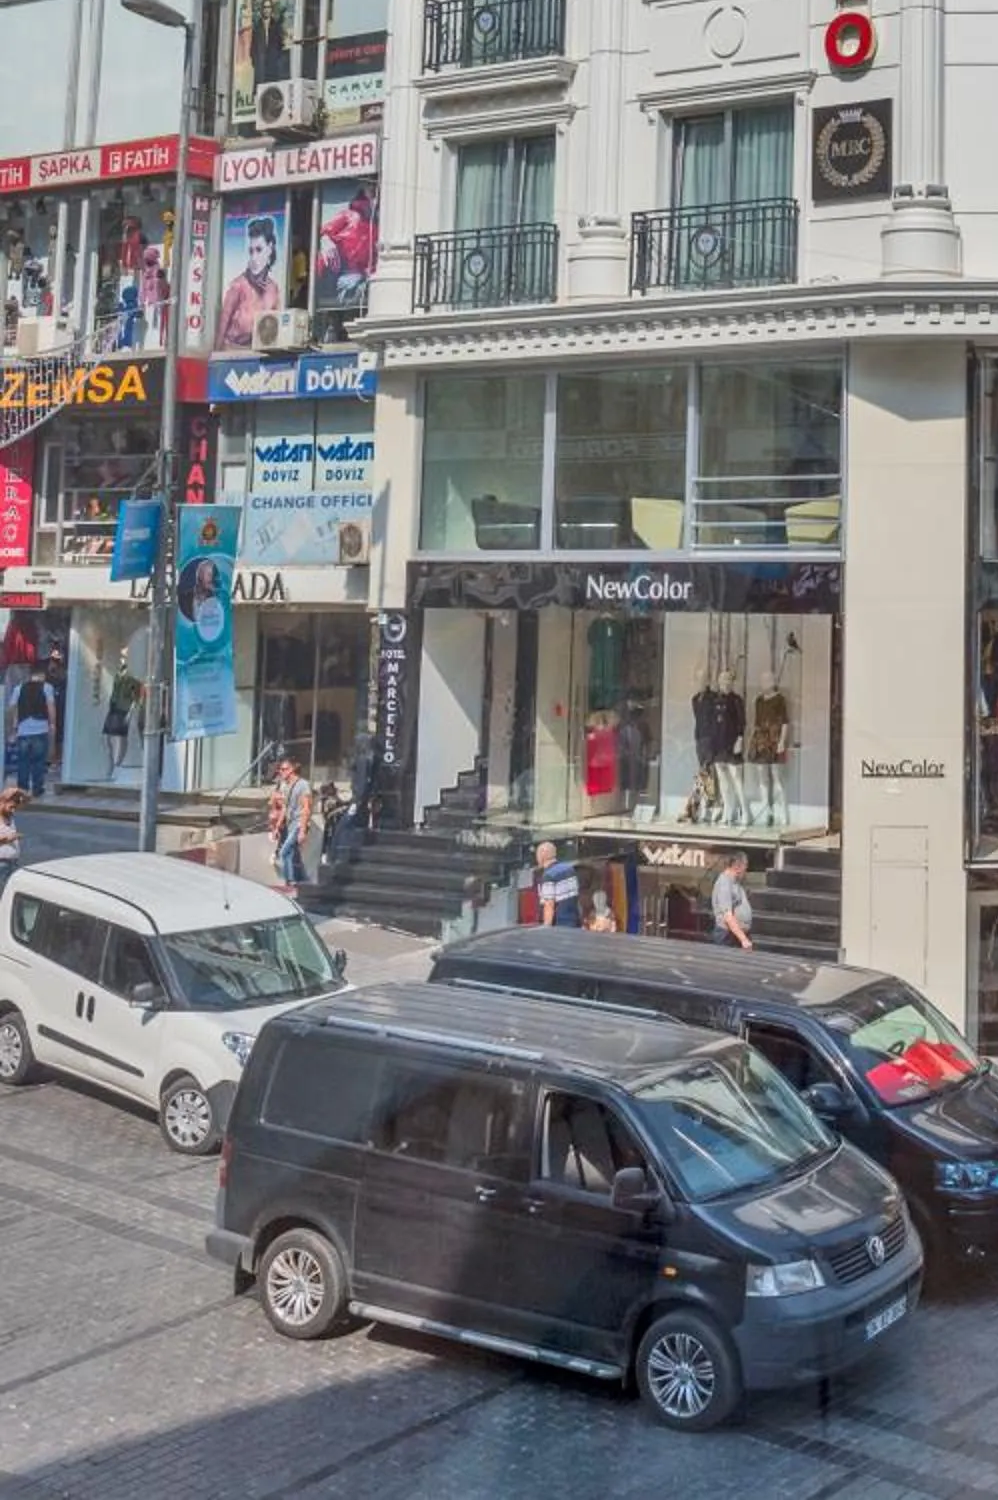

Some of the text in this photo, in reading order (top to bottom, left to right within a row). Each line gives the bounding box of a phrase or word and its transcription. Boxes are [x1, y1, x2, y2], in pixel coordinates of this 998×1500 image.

[39, 154, 92, 182] ŞAPKA
[124, 144, 170, 170] FATİH
[223, 142, 374, 183] LYON LEATHER
[251, 496, 315, 510] CHANGE
[586, 574, 692, 601] NewColor
[383, 662, 399, 764] MARCELLO
[861, 758, 946, 778] NewColor
